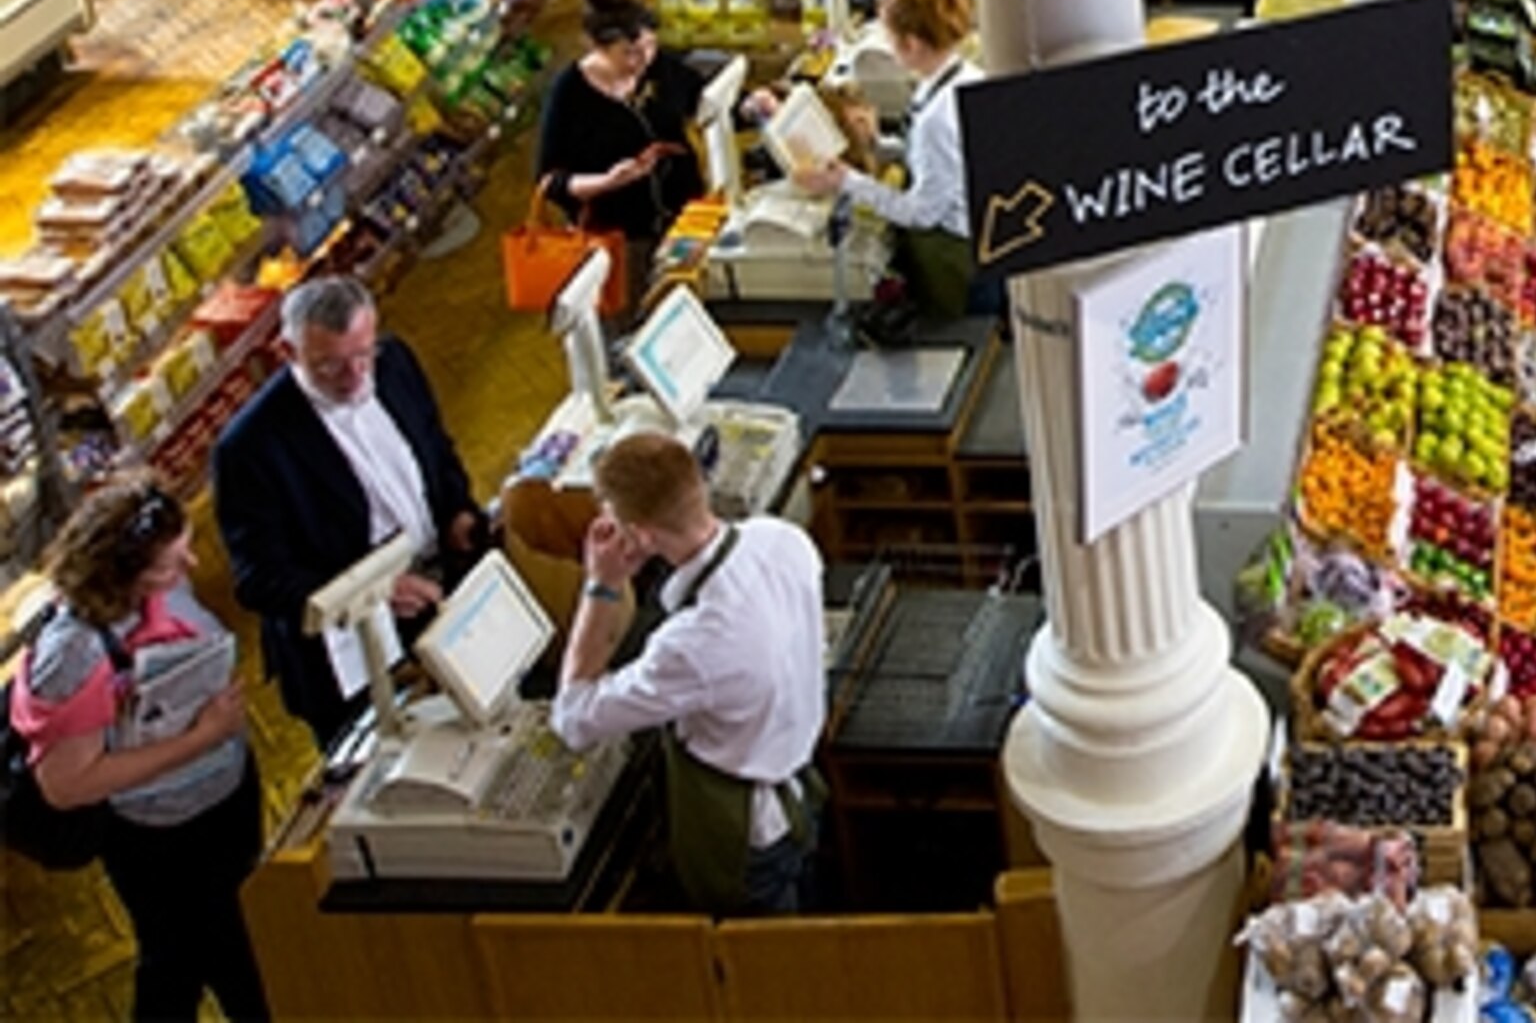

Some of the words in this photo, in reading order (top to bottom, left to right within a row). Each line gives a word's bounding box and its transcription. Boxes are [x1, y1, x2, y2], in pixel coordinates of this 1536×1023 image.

[1137, 84, 1188, 132] to
[1197, 70, 1284, 114] the
[1065, 152, 1205, 223] WINE
[1223, 114, 1416, 187] CELLAR
